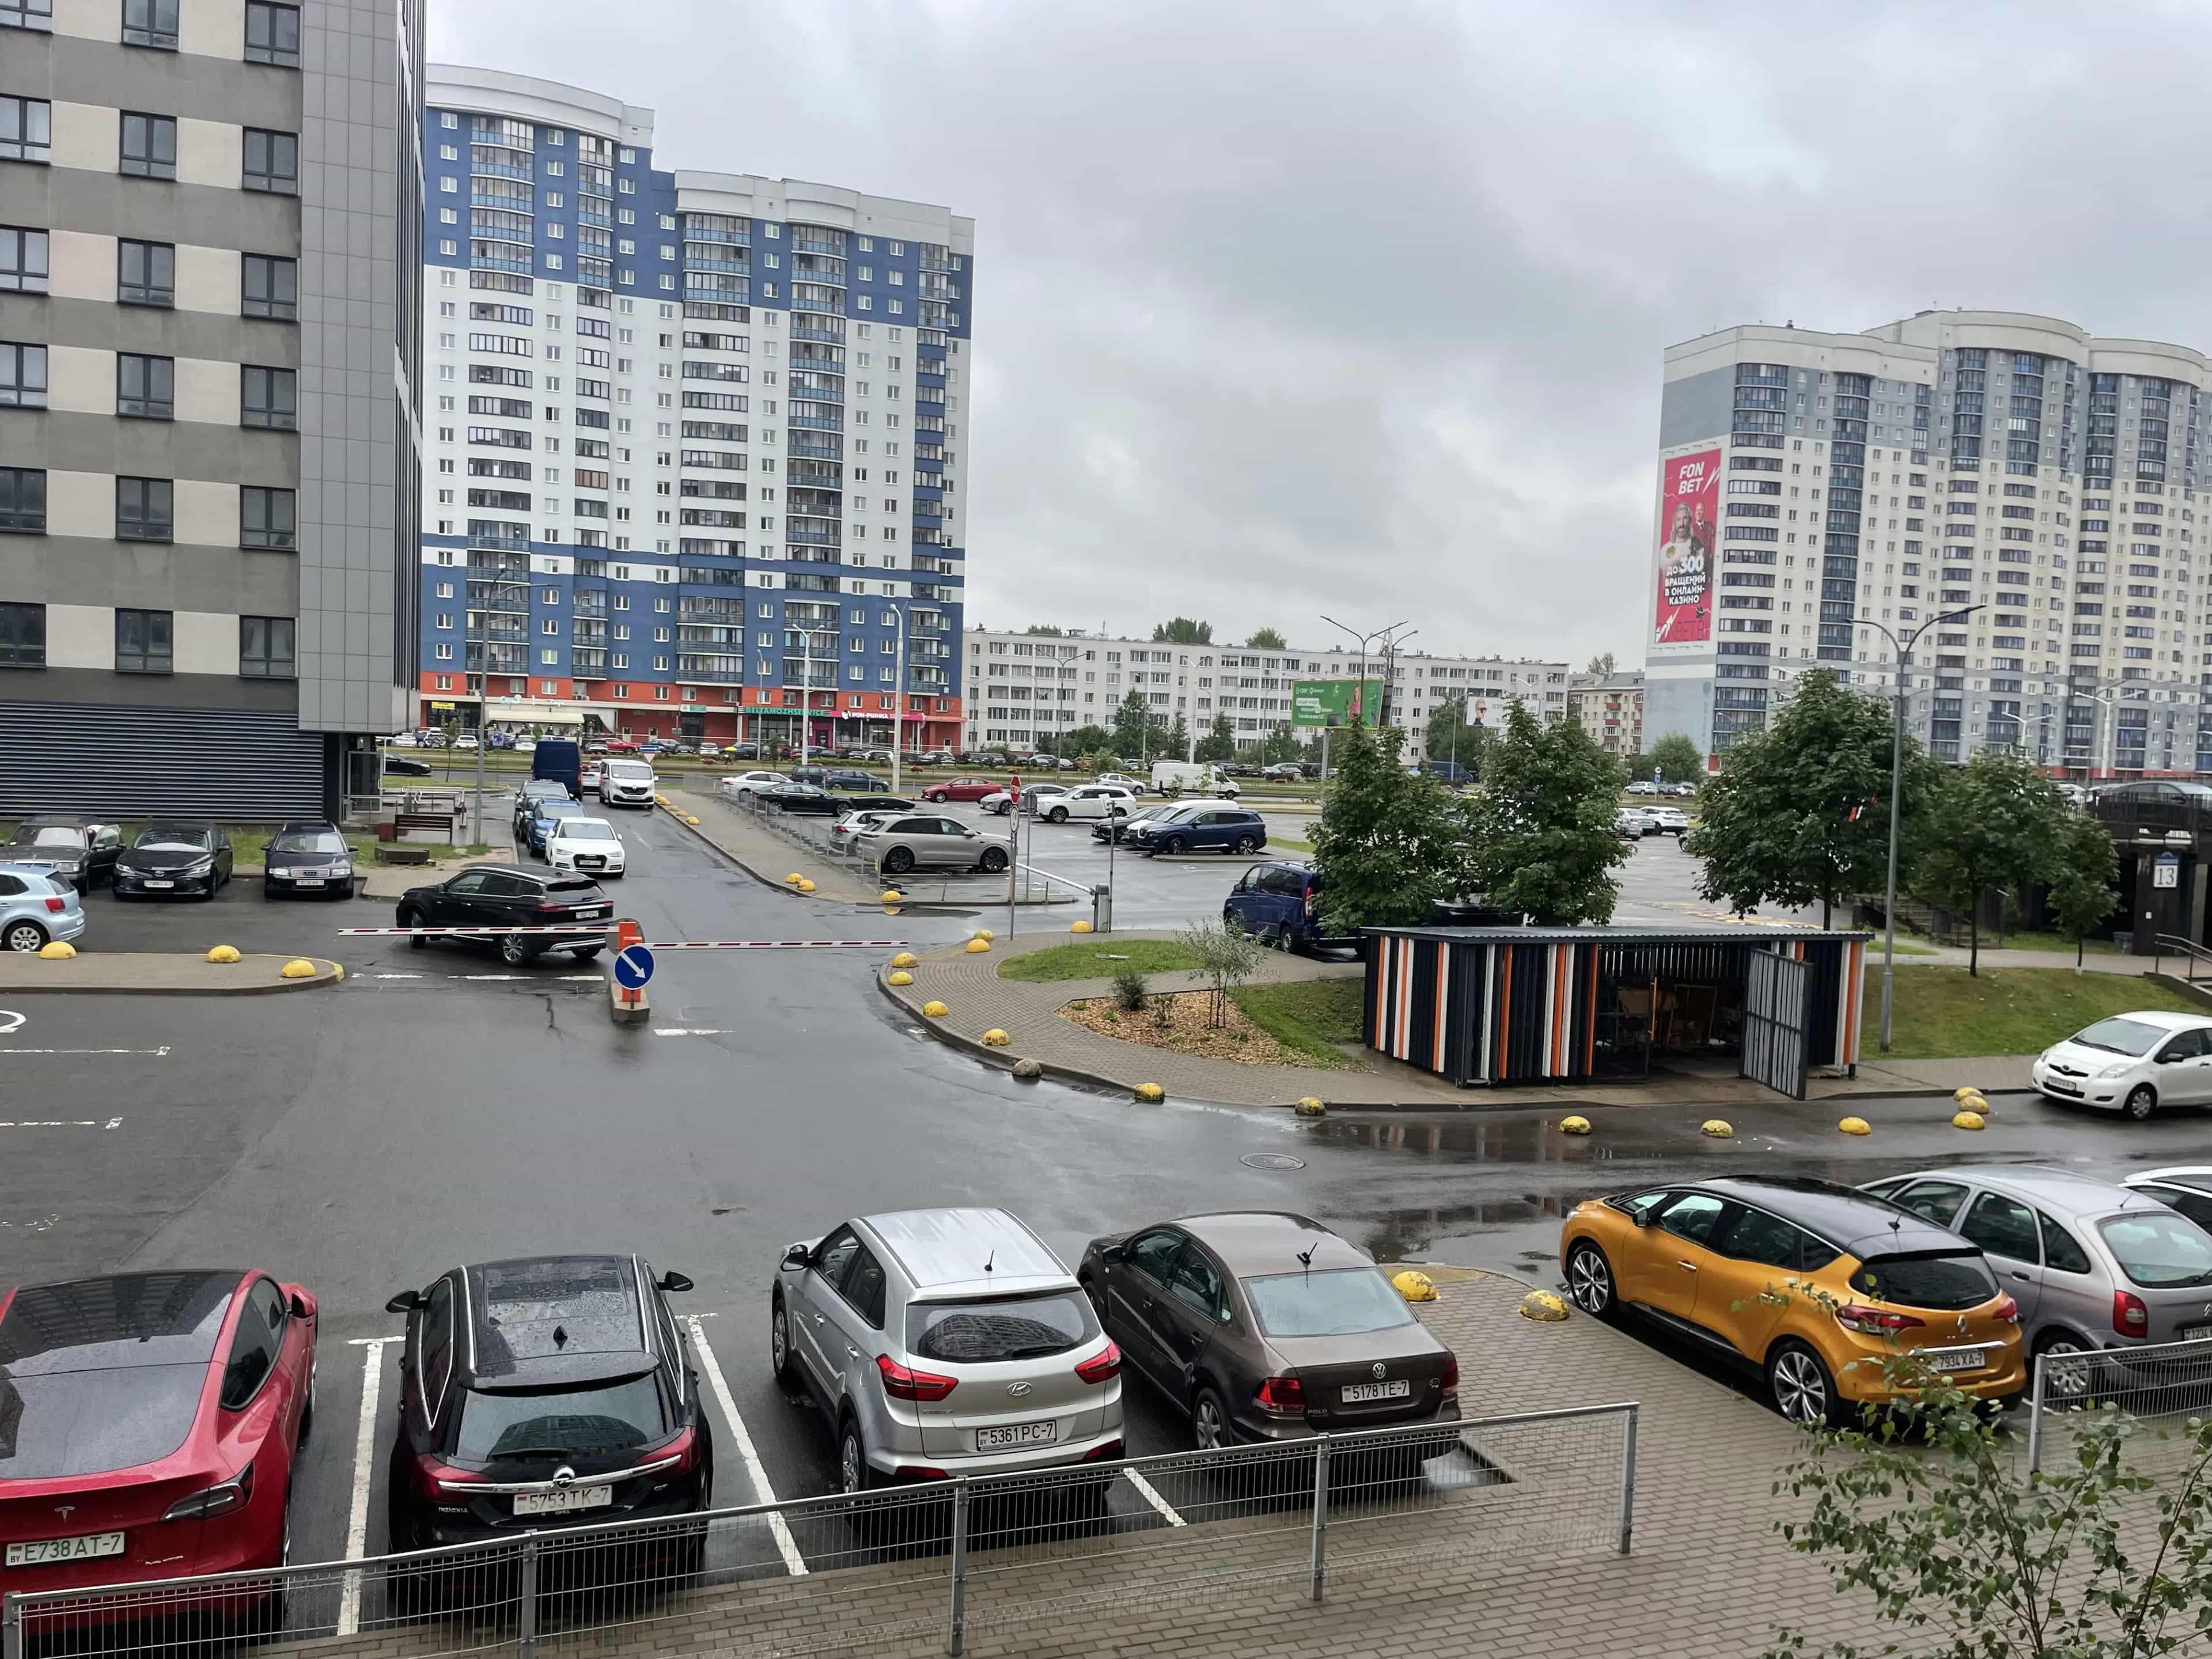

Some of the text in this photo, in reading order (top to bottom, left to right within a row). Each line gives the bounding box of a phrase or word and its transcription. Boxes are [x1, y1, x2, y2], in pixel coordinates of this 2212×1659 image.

[1679, 461, 1705, 479] FON
[1678, 478, 1704, 495] BET
[1667, 555, 1705, 576] ДО 300
[1665, 571, 1706, 587] ВРАЩЕНИЙ
[1665, 588, 1670, 596] В
[1669, 594, 1700, 605] КАЗИНО
[745, 706, 824, 717] BELTAMOZHSEVICE
[1011, 785, 1020, 794] STOP
[2157, 867, 2175, 885] 13
[10, 1554, 21, 1563] BY
